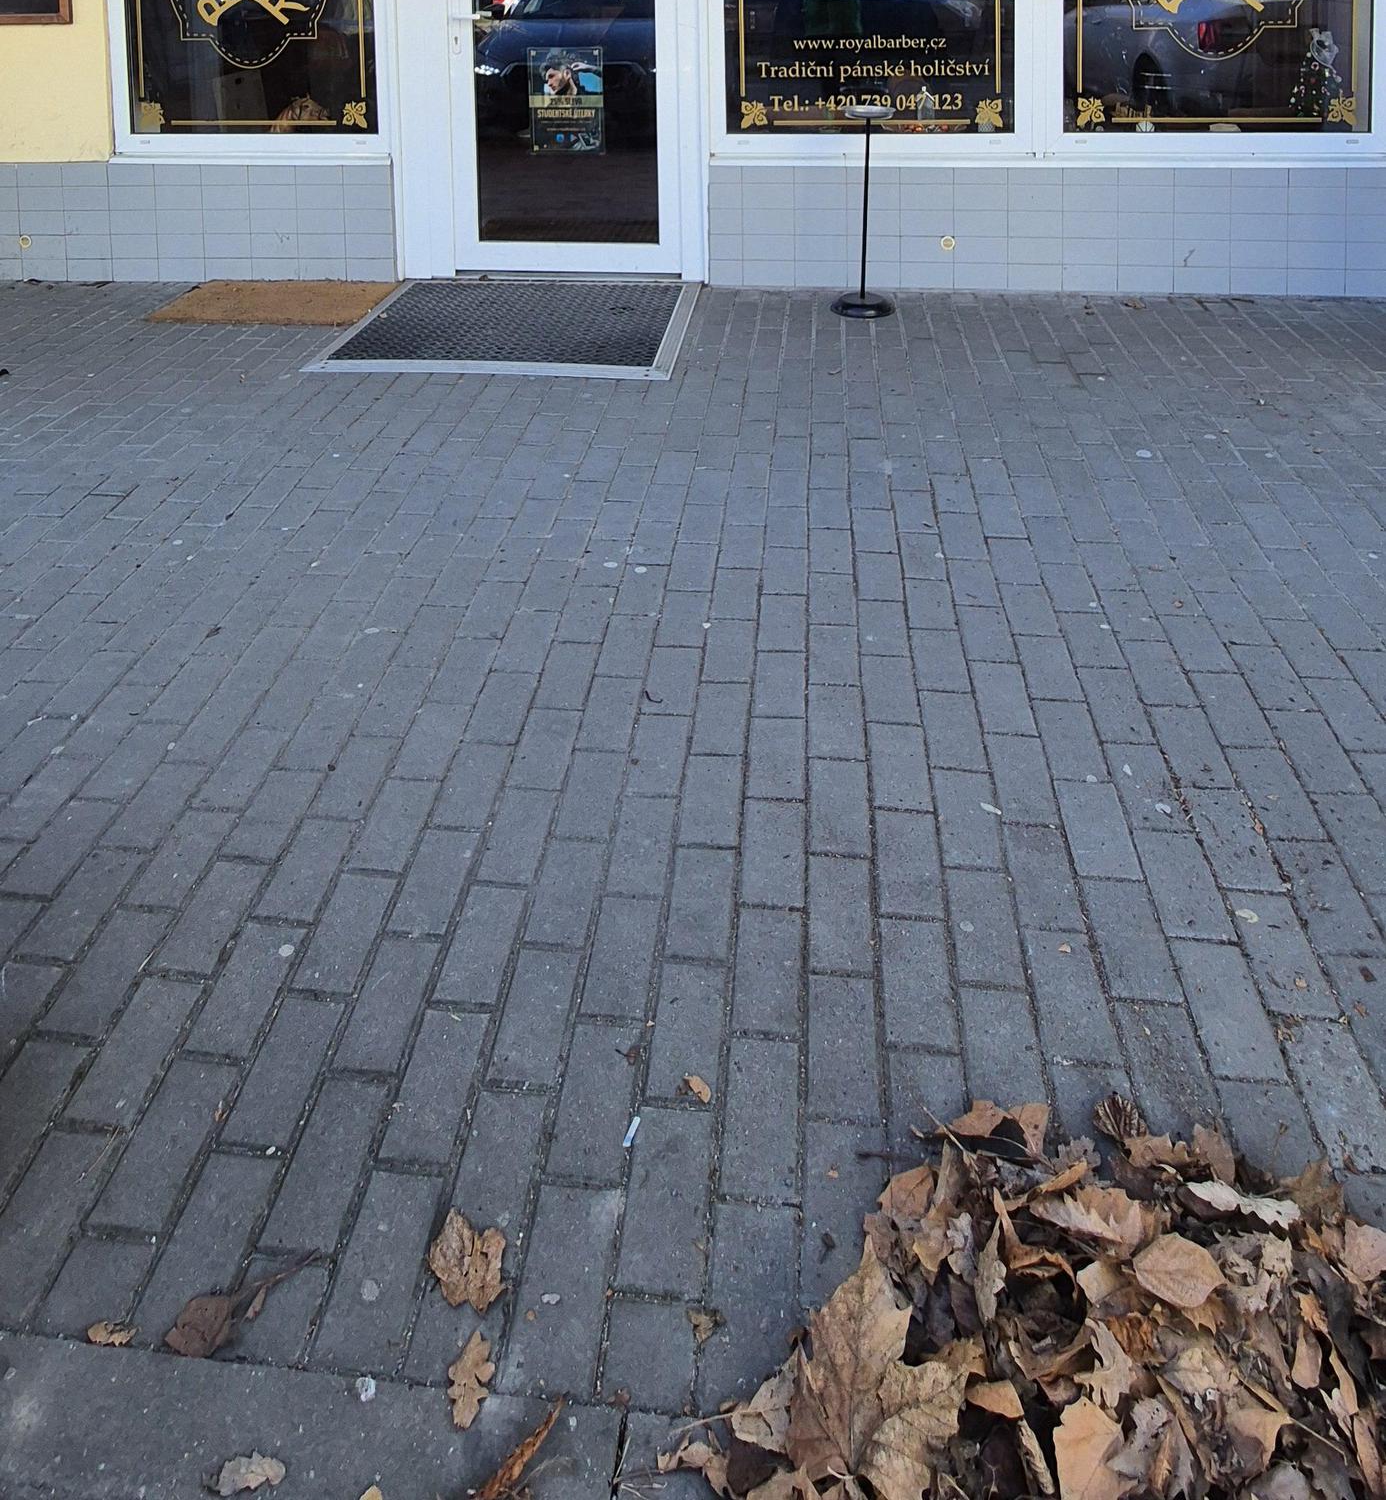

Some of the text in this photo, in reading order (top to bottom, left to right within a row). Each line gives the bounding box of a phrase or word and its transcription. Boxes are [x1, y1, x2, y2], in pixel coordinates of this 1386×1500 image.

[793, 35, 947, 53] www.royalbarber.cz
[757, 58, 990, 82] Tradiční pánské holičství
[770, 95, 809, 112] Tel.:
[815, 95, 857, 111] +420
[861, 94, 891, 107] 739
[932, 93, 963, 110] 123
